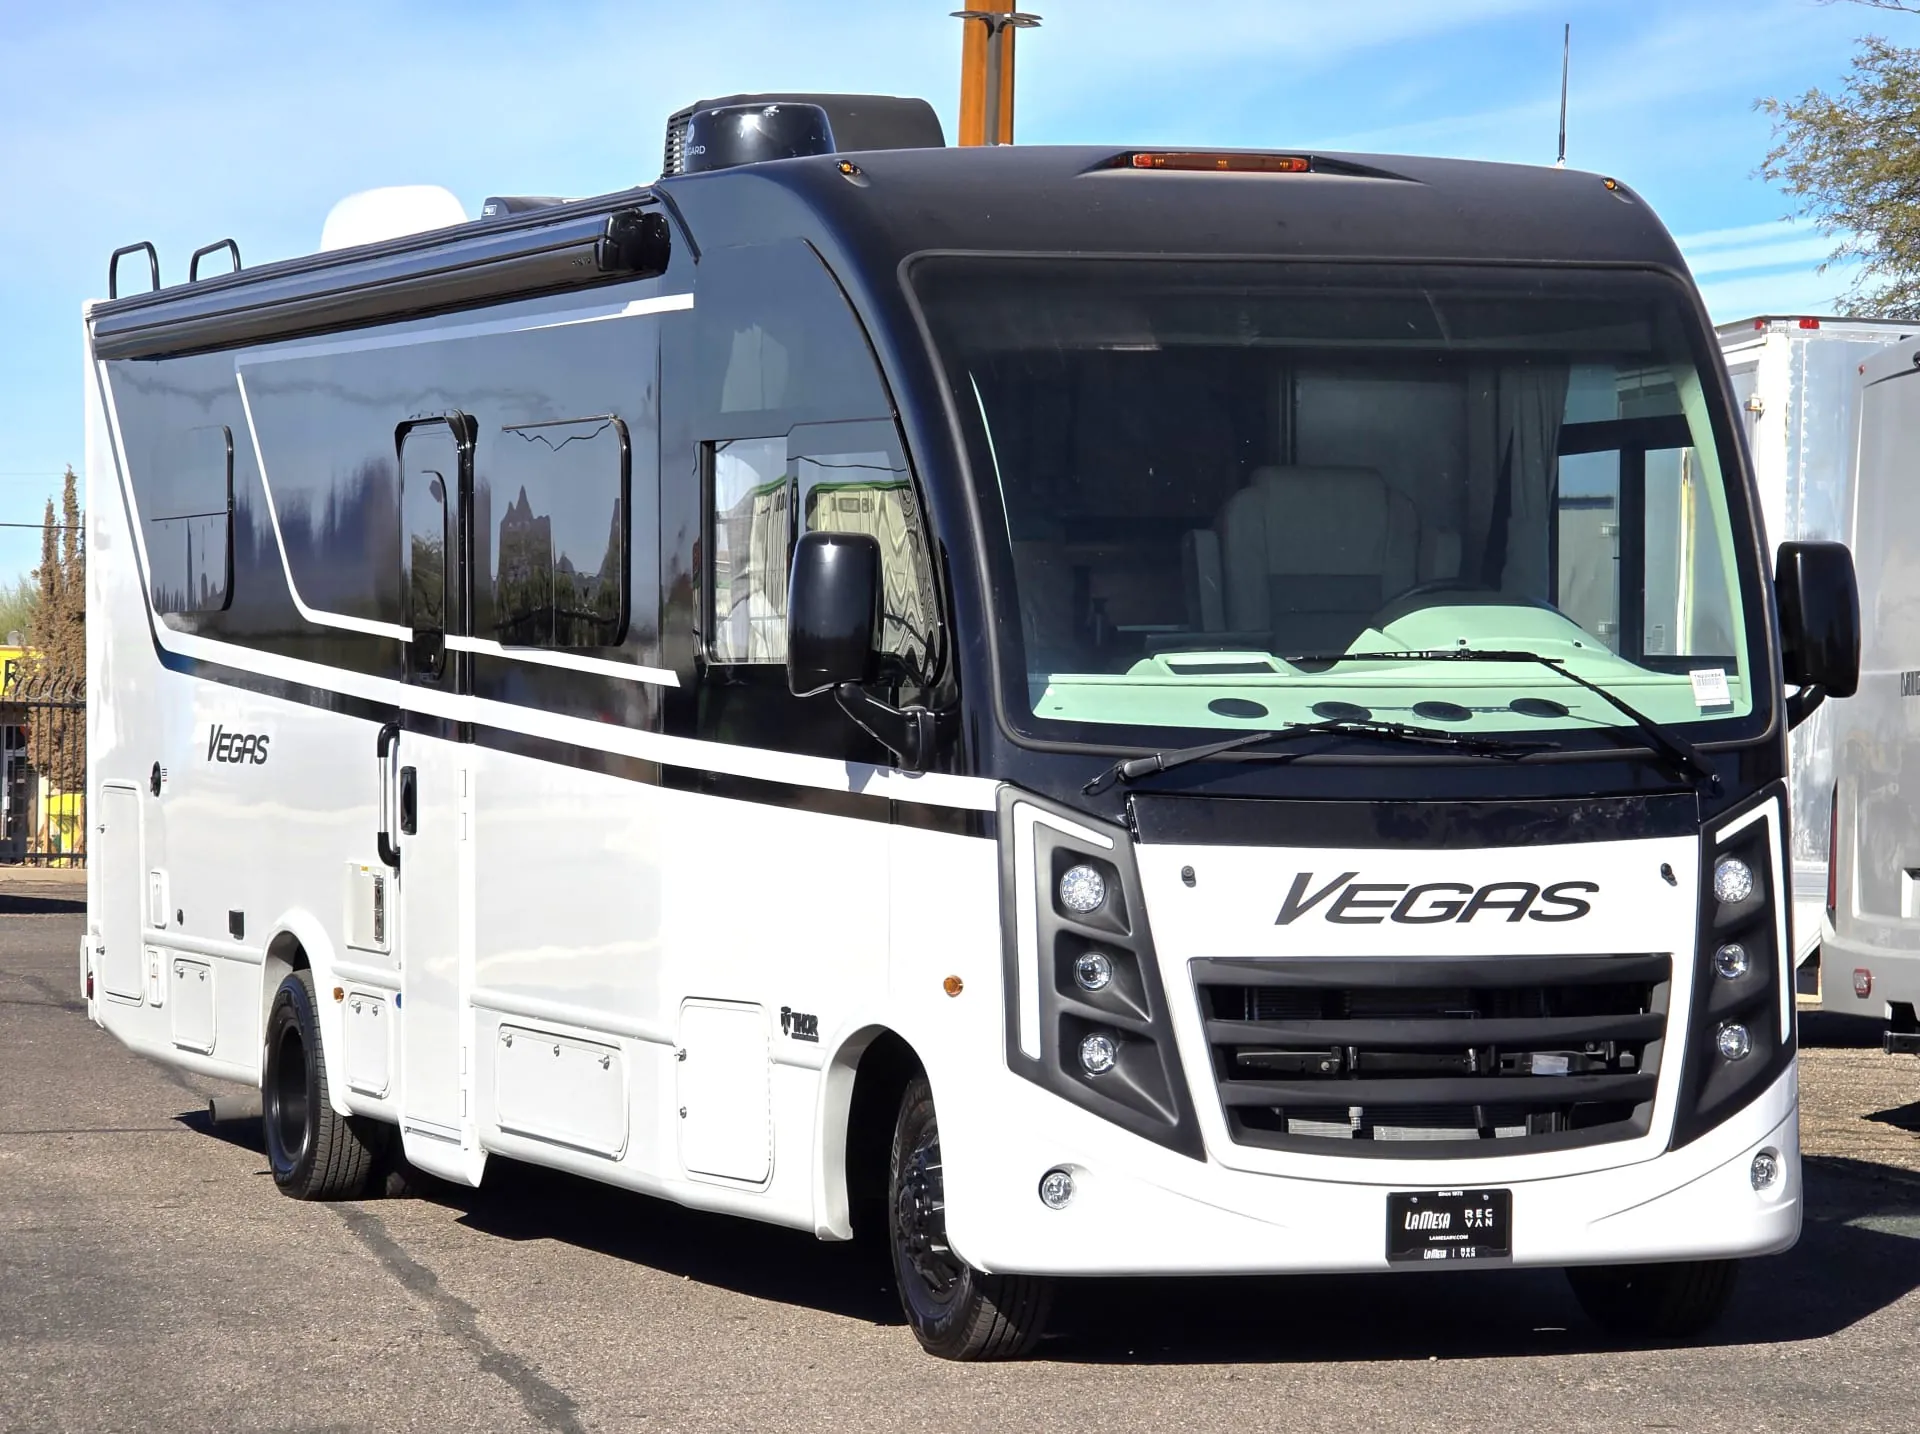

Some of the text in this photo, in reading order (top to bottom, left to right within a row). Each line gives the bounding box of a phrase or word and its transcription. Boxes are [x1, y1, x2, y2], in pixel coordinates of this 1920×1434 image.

[207, 723, 270, 765] VEGAS
[1274, 871, 1600, 925] VEGAS
[1464, 1208, 1493, 1218] REC
[1464, 1218, 1493, 1228] VAN
